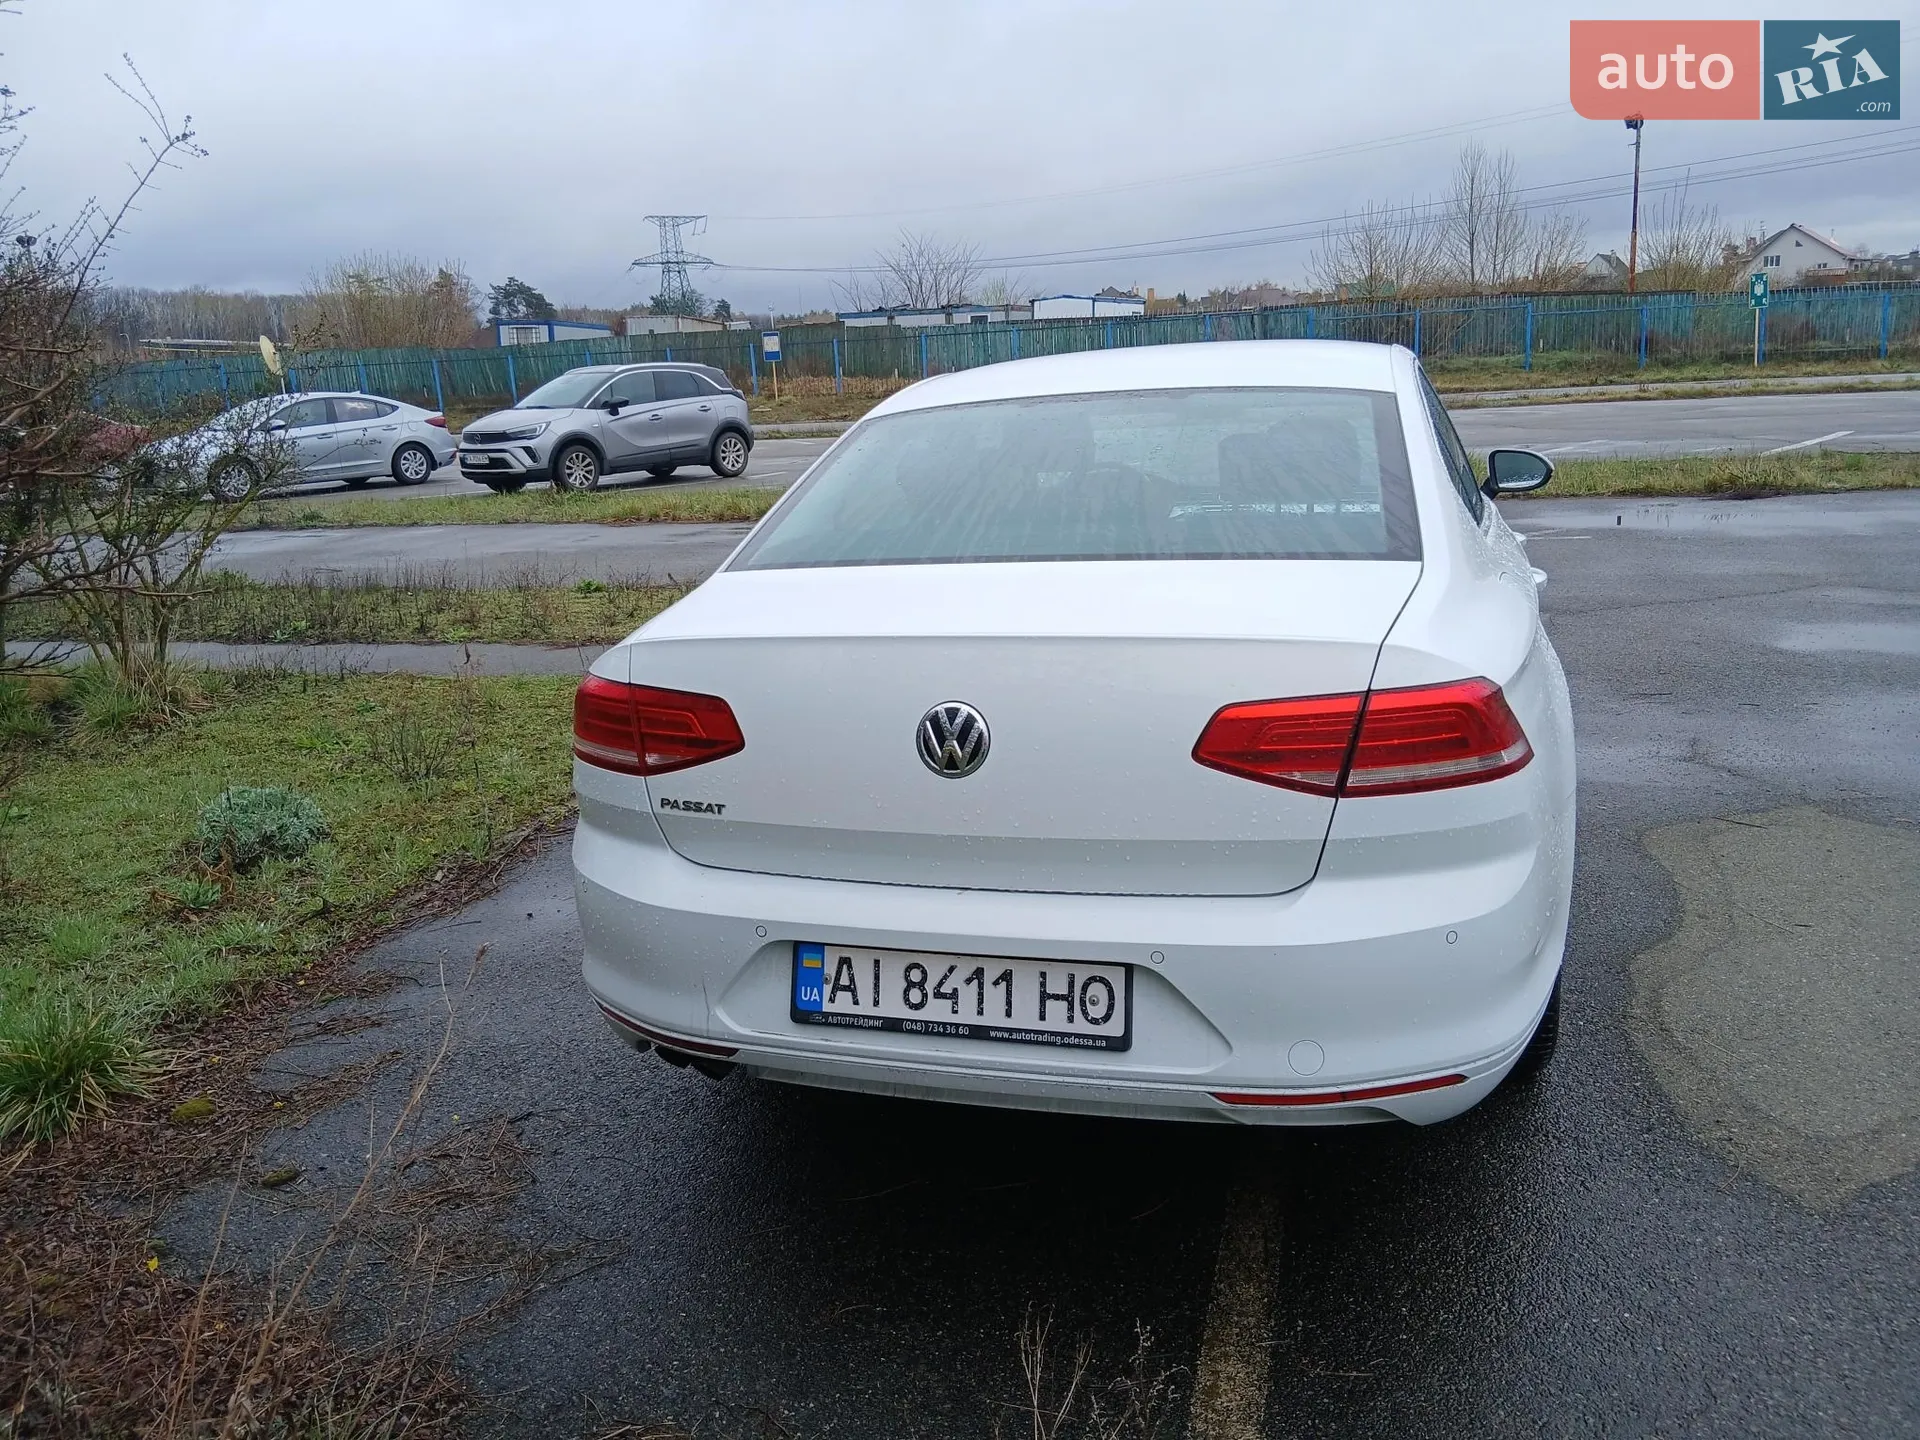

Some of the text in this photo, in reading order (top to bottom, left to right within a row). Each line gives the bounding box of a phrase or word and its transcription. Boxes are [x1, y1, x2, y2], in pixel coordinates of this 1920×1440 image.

[660, 797, 726, 815] PASSAT
[801, 986, 820, 1002] UA
[828, 956, 1115, 1026] AI 8411 HO
[827, 1015, 884, 1028] АВТОТРЕЙДИНГ
[902, 1020, 926, 1033] (048)
[928, 1023, 944, 1033] 734
[958, 1026, 970, 1036] 60
[989, 1030, 1107, 1047] www.autotrading.odessa.ua
